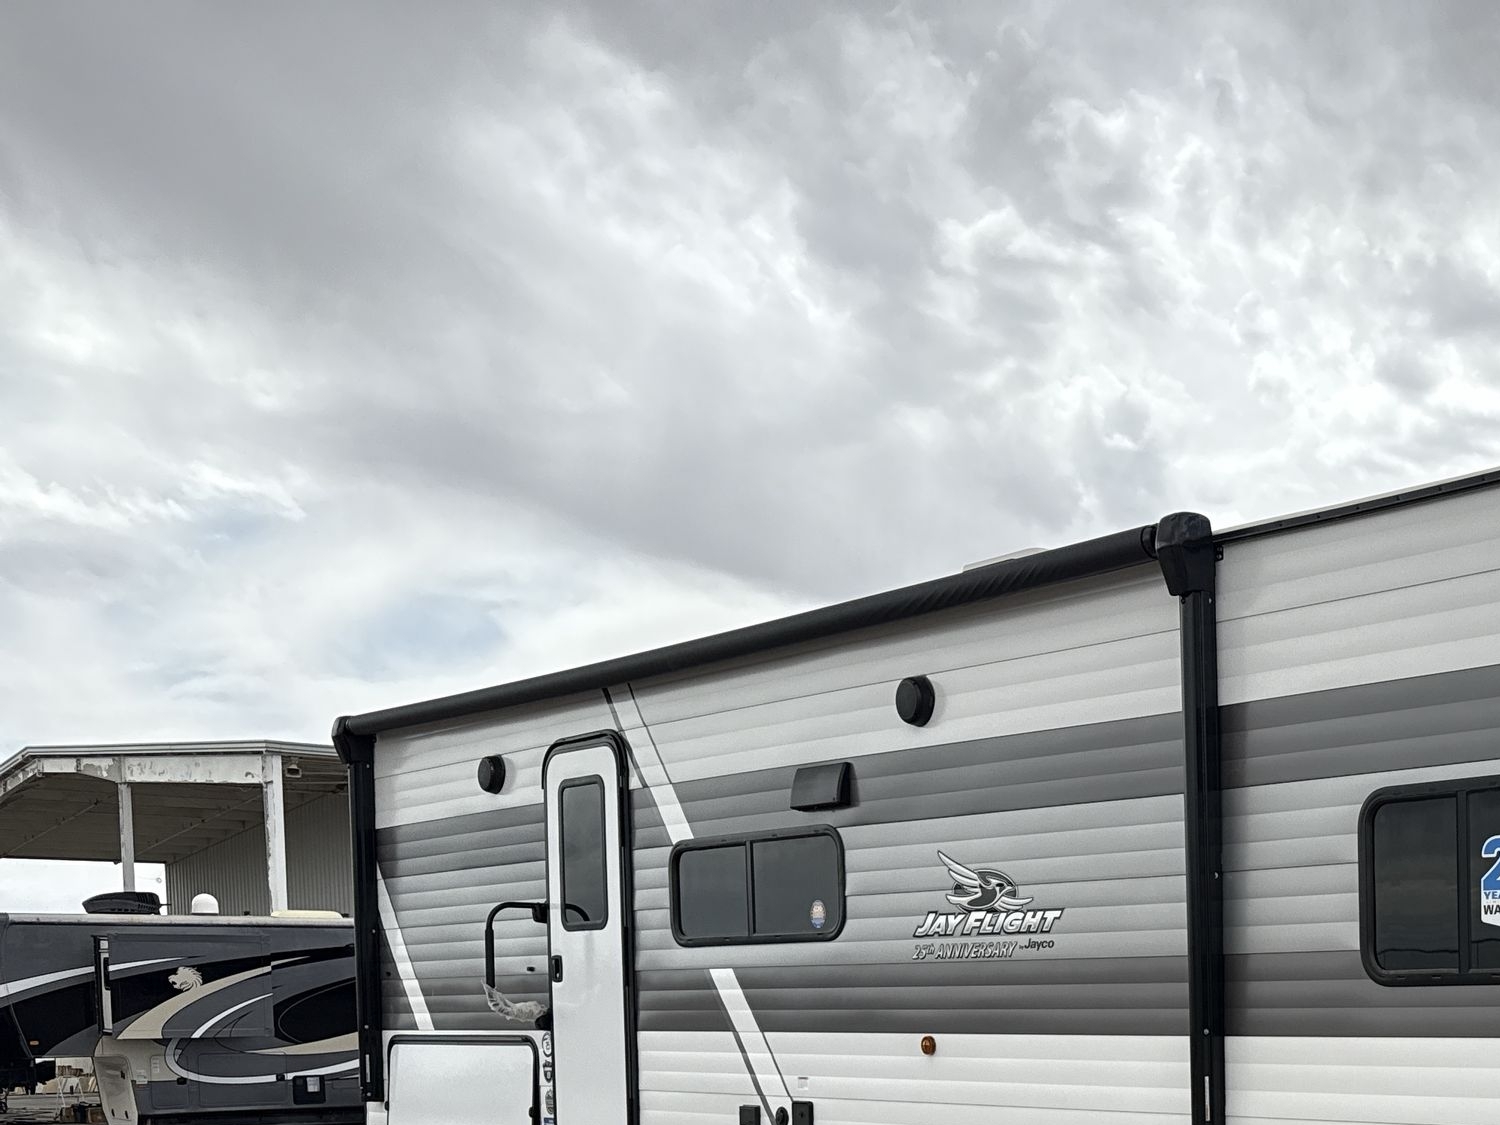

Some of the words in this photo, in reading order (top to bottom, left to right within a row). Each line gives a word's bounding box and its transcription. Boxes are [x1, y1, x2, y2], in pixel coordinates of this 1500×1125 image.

[913, 911, 966, 937] JAY
[961, 908, 1064, 936] FLIGHT
[934, 940, 1018, 960] ANNIVERSARY
[1024, 938, 1055, 951] Jayco
